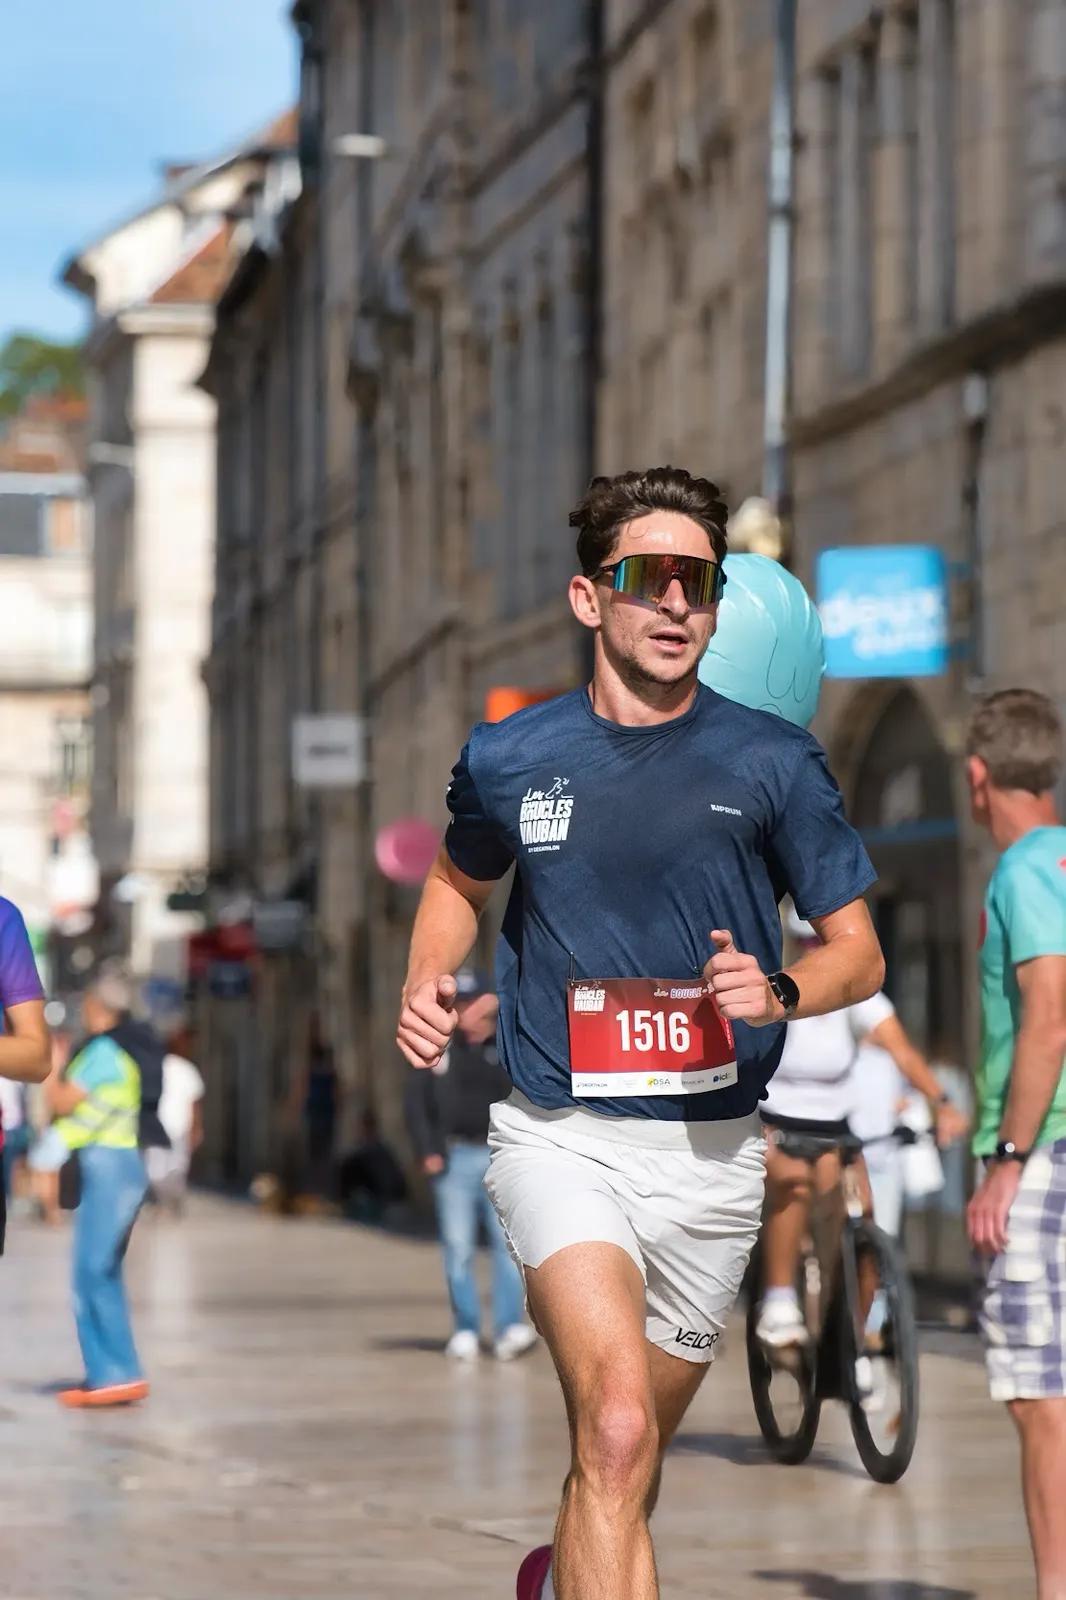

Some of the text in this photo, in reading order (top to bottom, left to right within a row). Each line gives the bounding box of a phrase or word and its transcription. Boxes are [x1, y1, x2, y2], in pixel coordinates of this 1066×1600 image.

[522, 788, 544, 802] Les
[520, 799, 574, 822] BOUCLES
[519, 818, 570, 845] VAUBAN
[670, 987, 702, 999] BOUCLE
[616, 1009, 690, 1053] 1516
